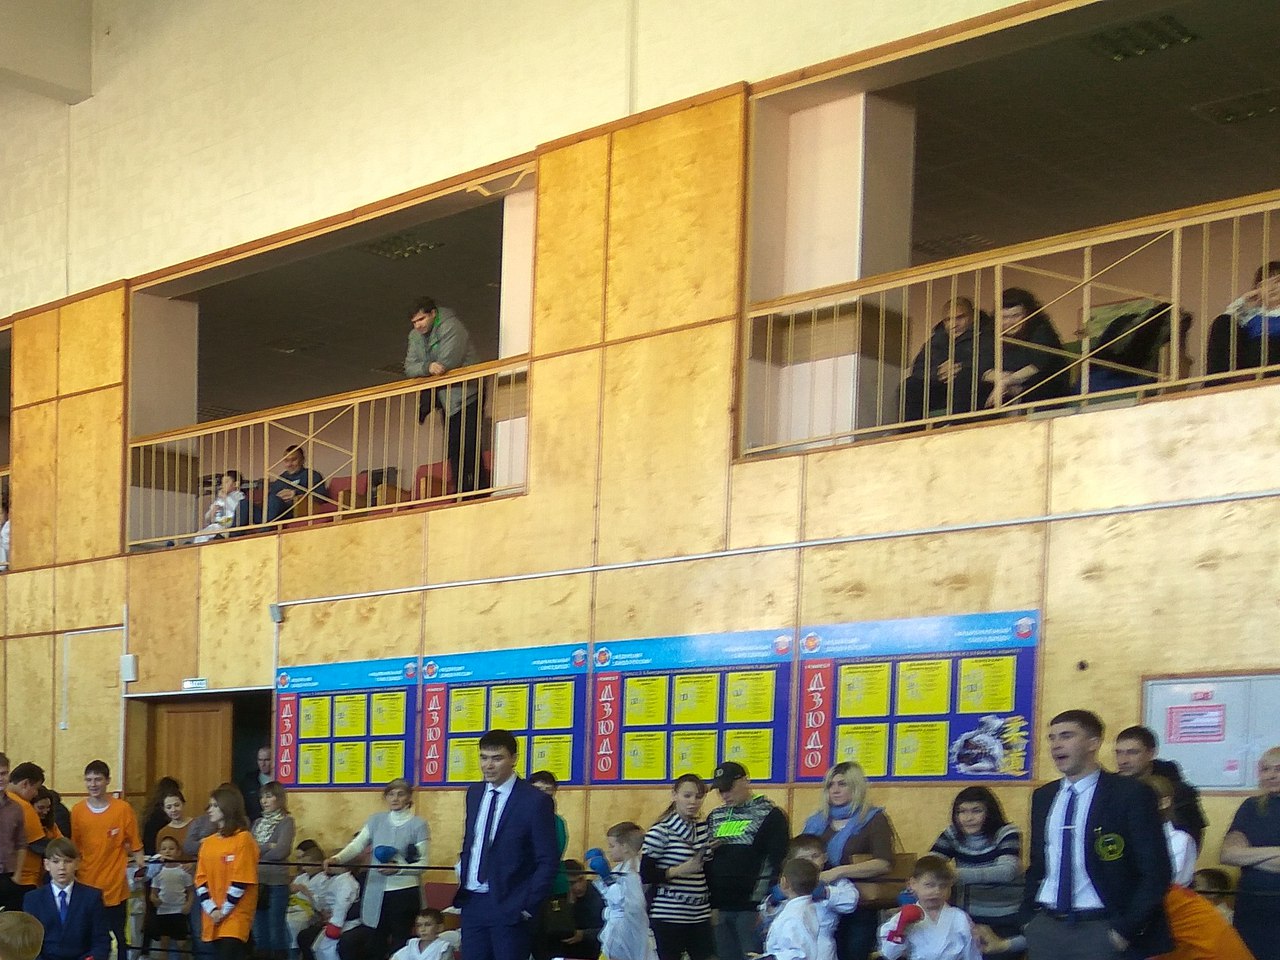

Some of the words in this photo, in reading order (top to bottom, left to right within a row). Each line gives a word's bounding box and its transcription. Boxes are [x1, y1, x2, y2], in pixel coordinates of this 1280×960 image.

[279, 703, 294, 778] ДЗЮДО
[425, 695, 442, 775] ДЗЮДО
[597, 684, 615, 772] ДЗЮДО
[804, 672, 826, 769] ДЗЮДО
